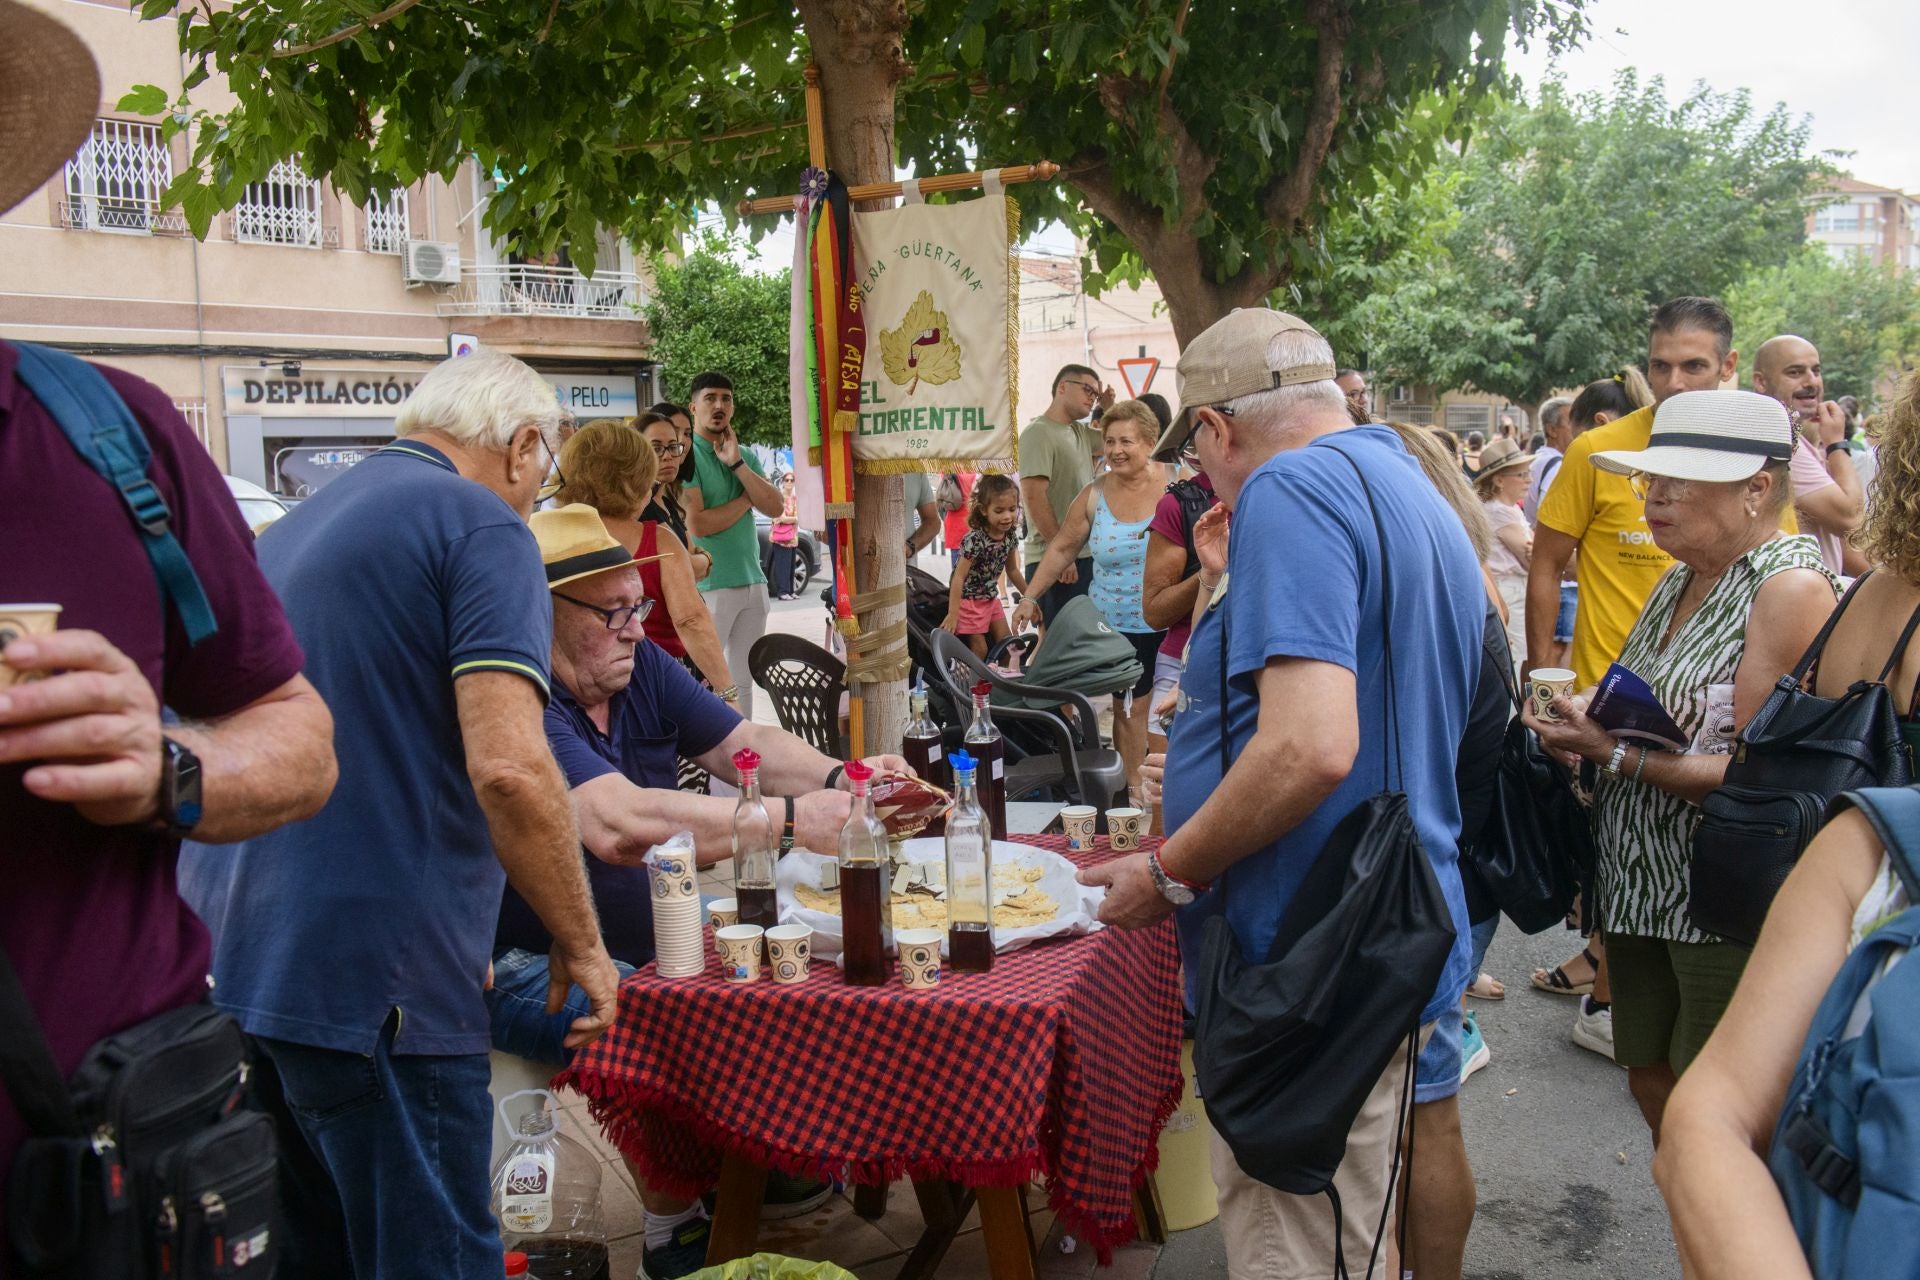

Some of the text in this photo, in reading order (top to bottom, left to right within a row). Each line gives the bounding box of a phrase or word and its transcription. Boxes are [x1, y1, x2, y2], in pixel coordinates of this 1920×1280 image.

[571, 387, 609, 407] PELO
[860, 382, 886, 403] EL
[858, 407, 995, 436] CORRENTAL
[905, 438, 929, 448] 1982
[1618, 551, 1635, 560] NEW
